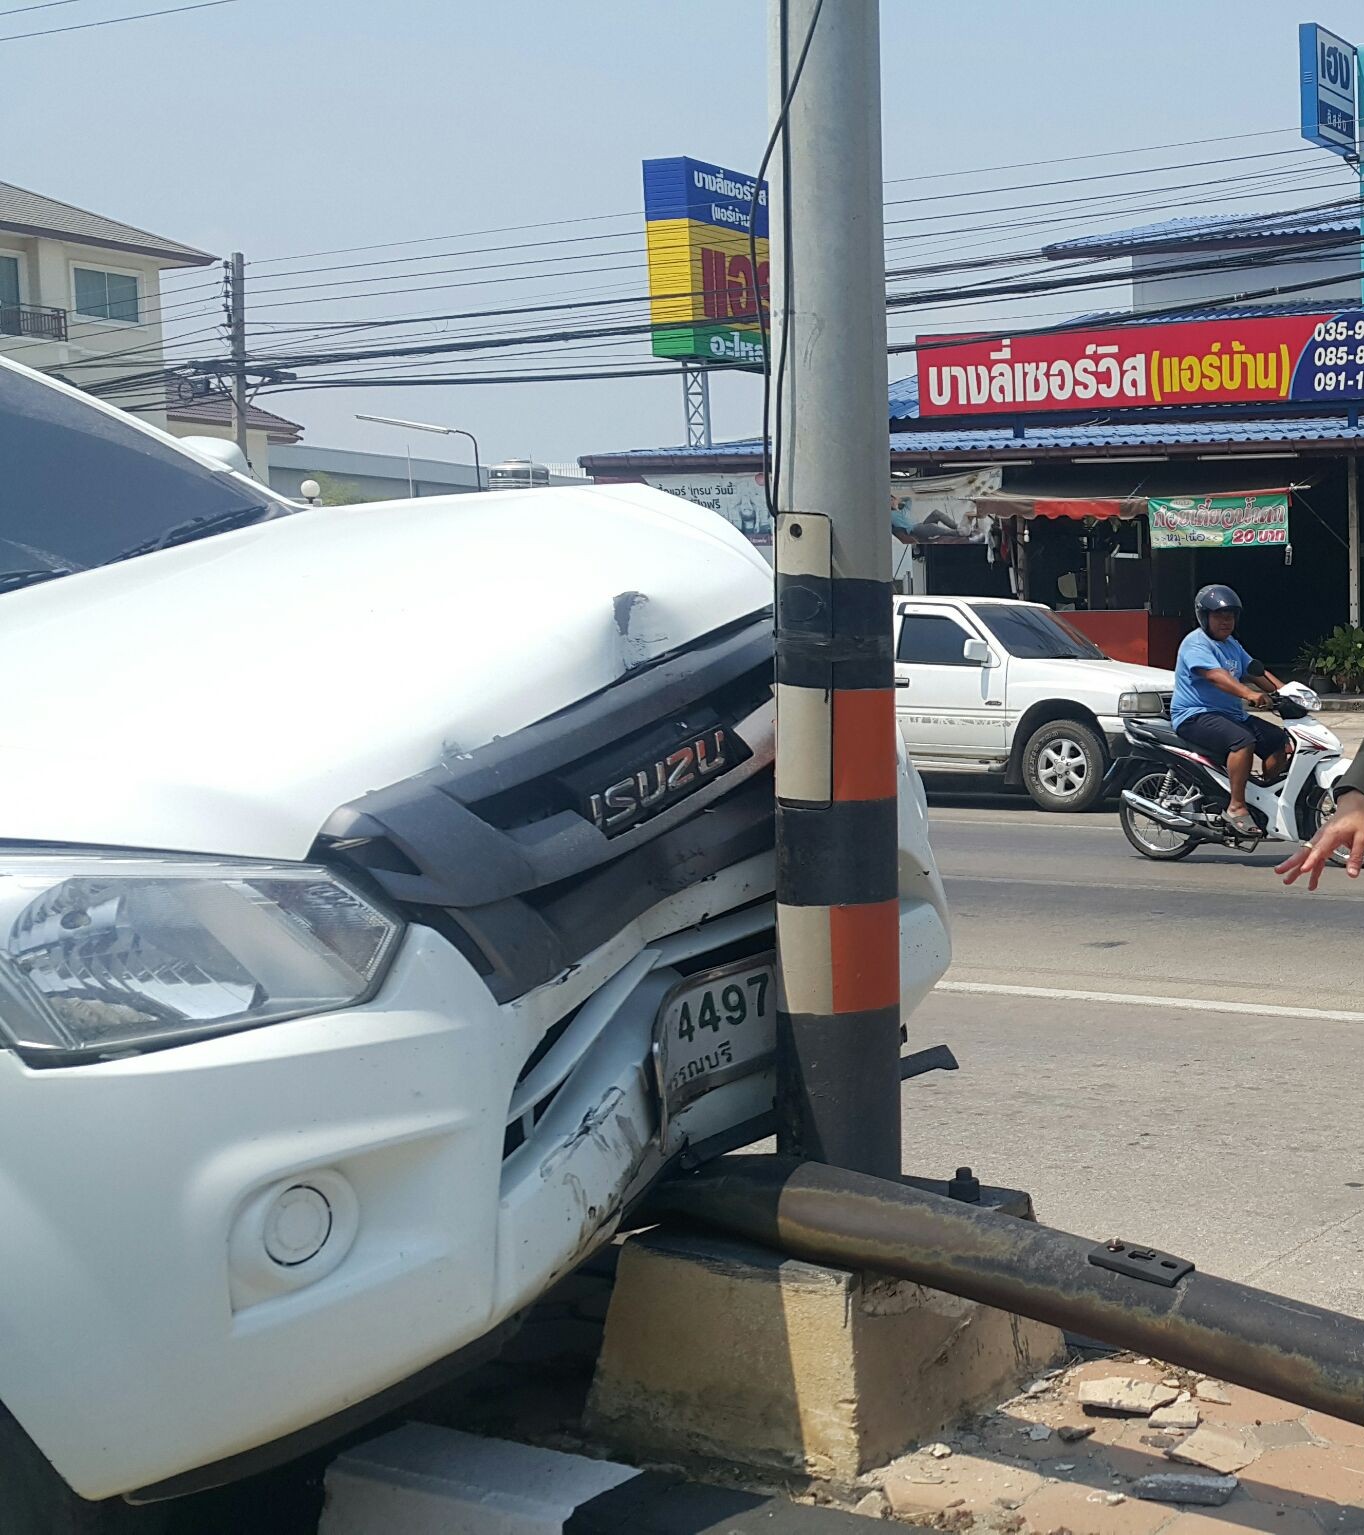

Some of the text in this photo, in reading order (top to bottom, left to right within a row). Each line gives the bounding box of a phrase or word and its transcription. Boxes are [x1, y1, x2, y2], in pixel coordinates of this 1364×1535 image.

[1320, 41, 1351, 91] เฮง
[1232, 529, 1256, 544] 20
[589, 730, 726, 828] ISUZU
[678, 972, 769, 1043] 4497
